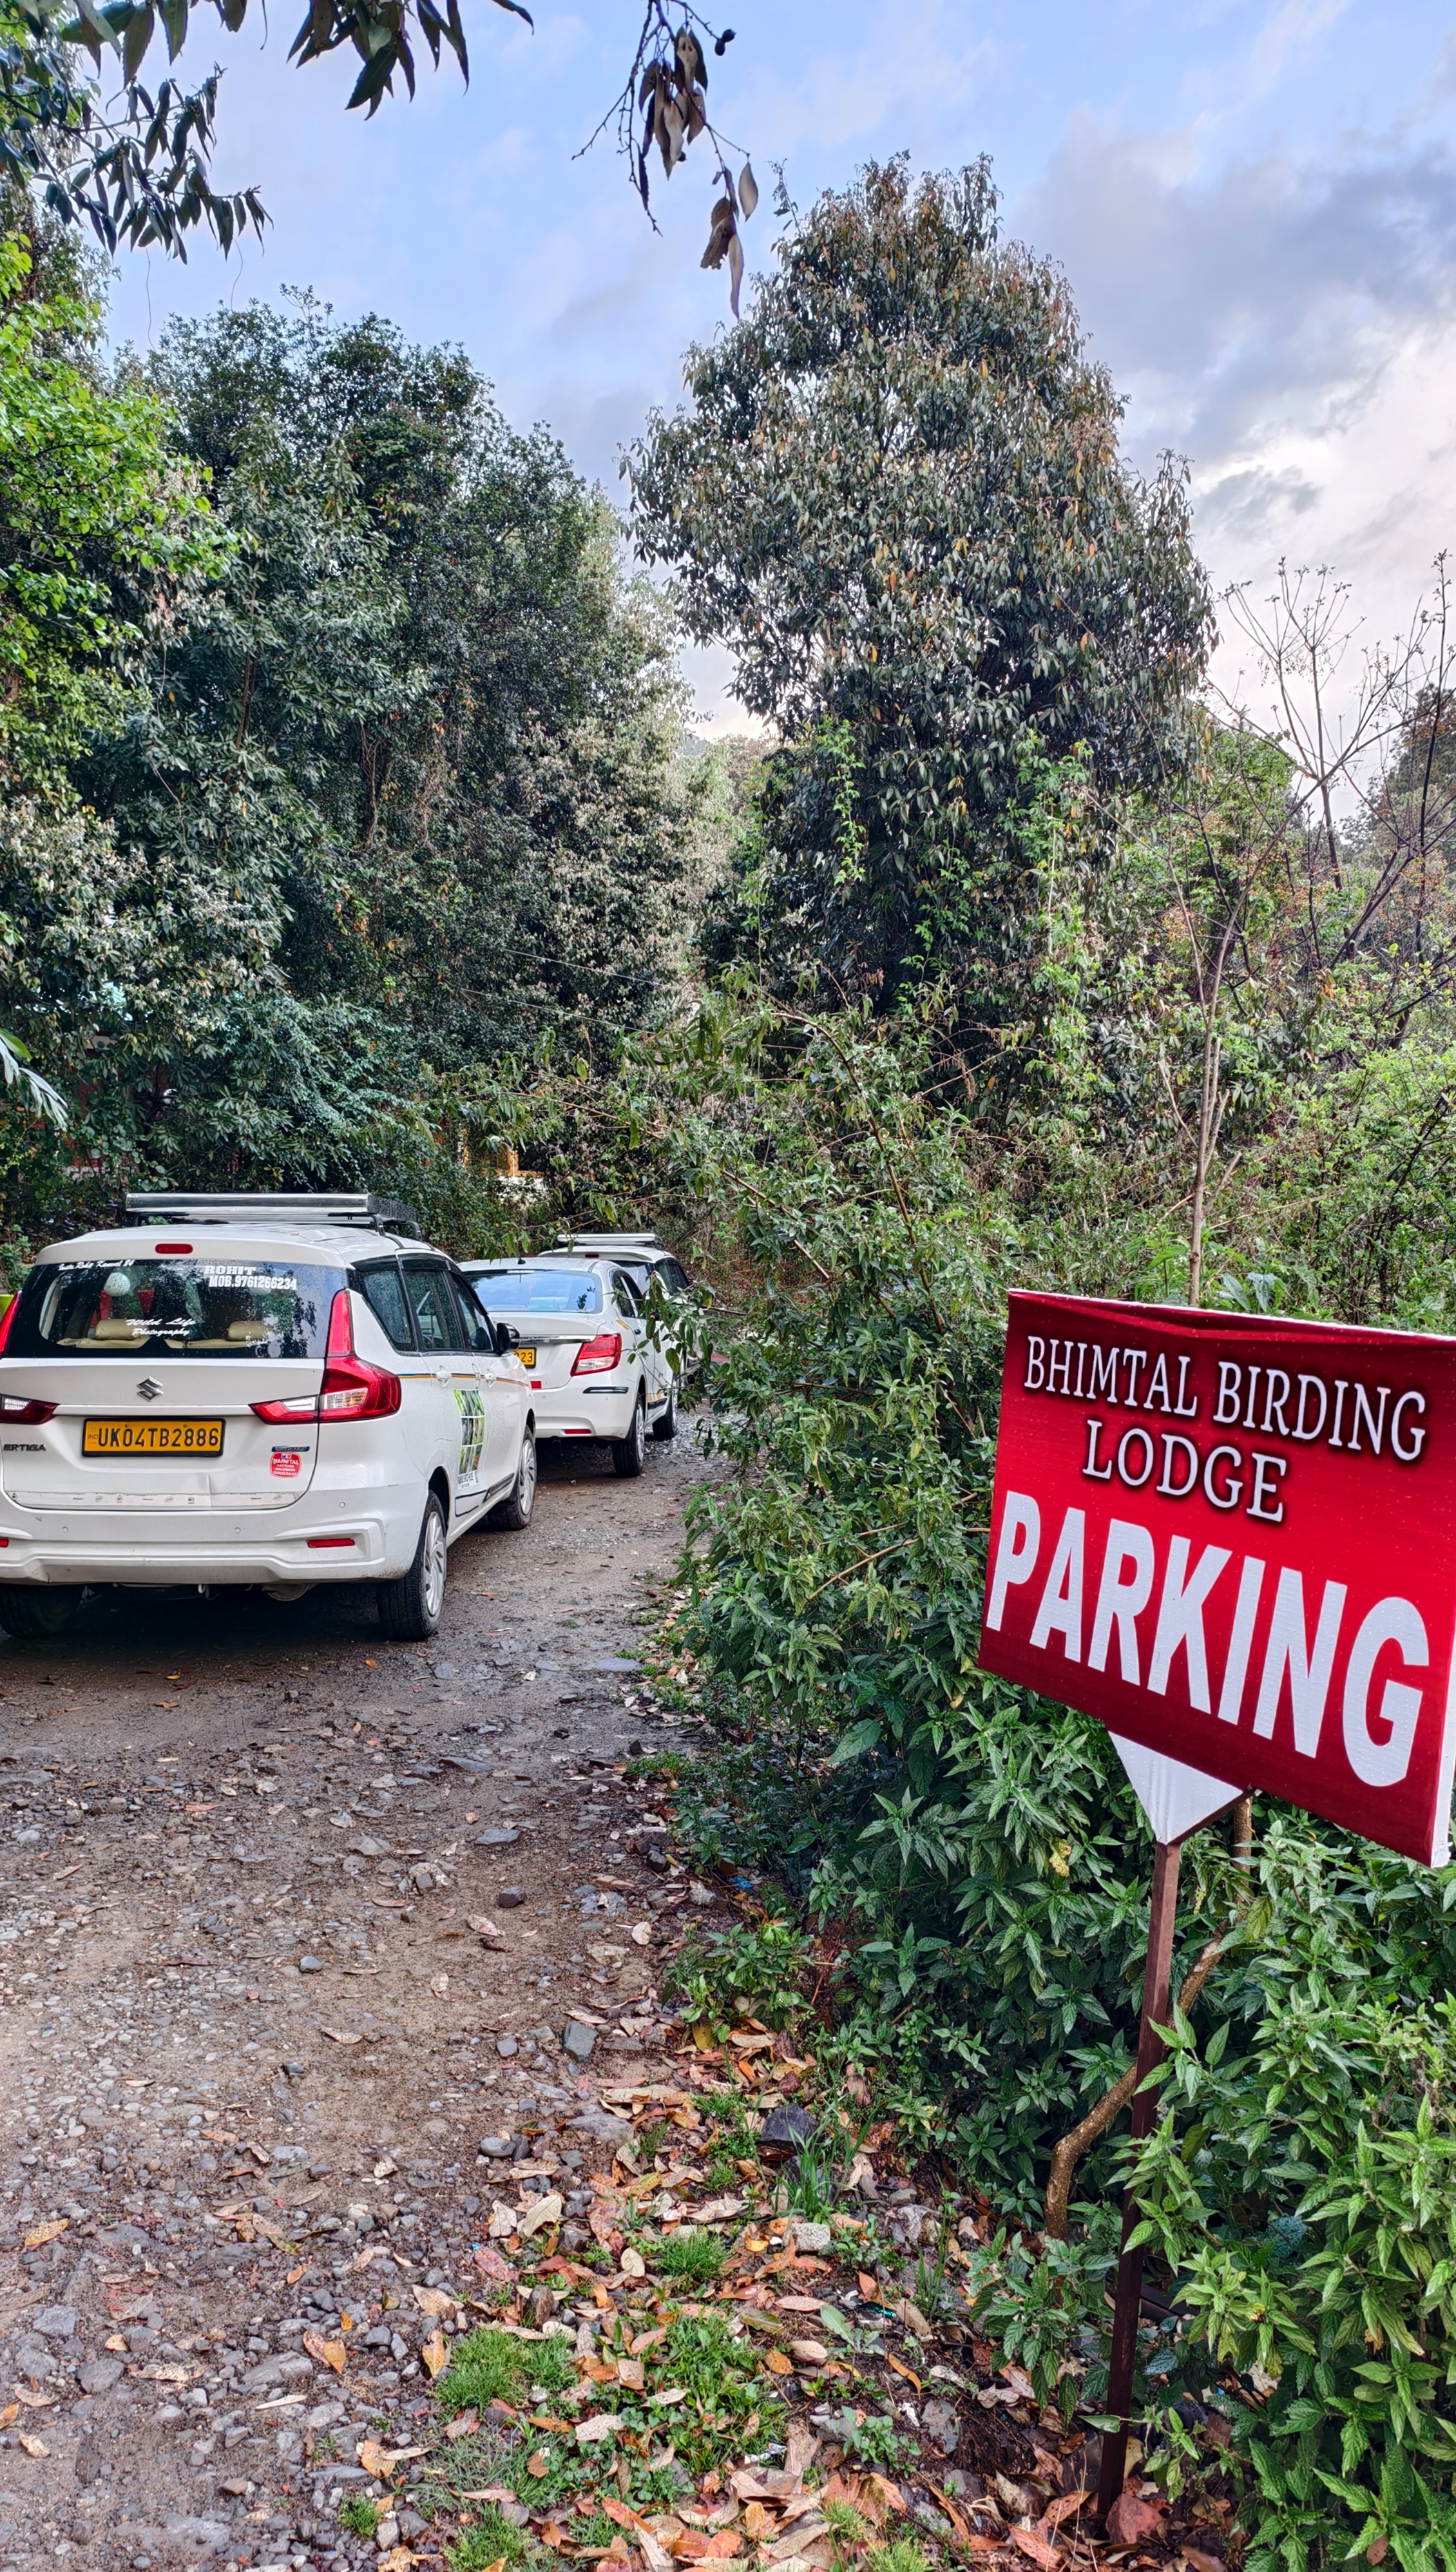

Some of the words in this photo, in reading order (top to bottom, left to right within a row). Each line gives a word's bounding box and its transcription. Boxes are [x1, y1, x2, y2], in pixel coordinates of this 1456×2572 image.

[204, 1265, 256, 1275] ROHIT
[132, 1327, 189, 1337] Photography
[1024, 1336, 1197, 1418] BHIMTAL
[1213, 1361, 1426, 1461] BIRDING
[98, 1428, 219, 1447] UK04TB2886
[1083, 1420, 1287, 1522] LODGE
[986, 1490, 1430, 1787] PARKING
